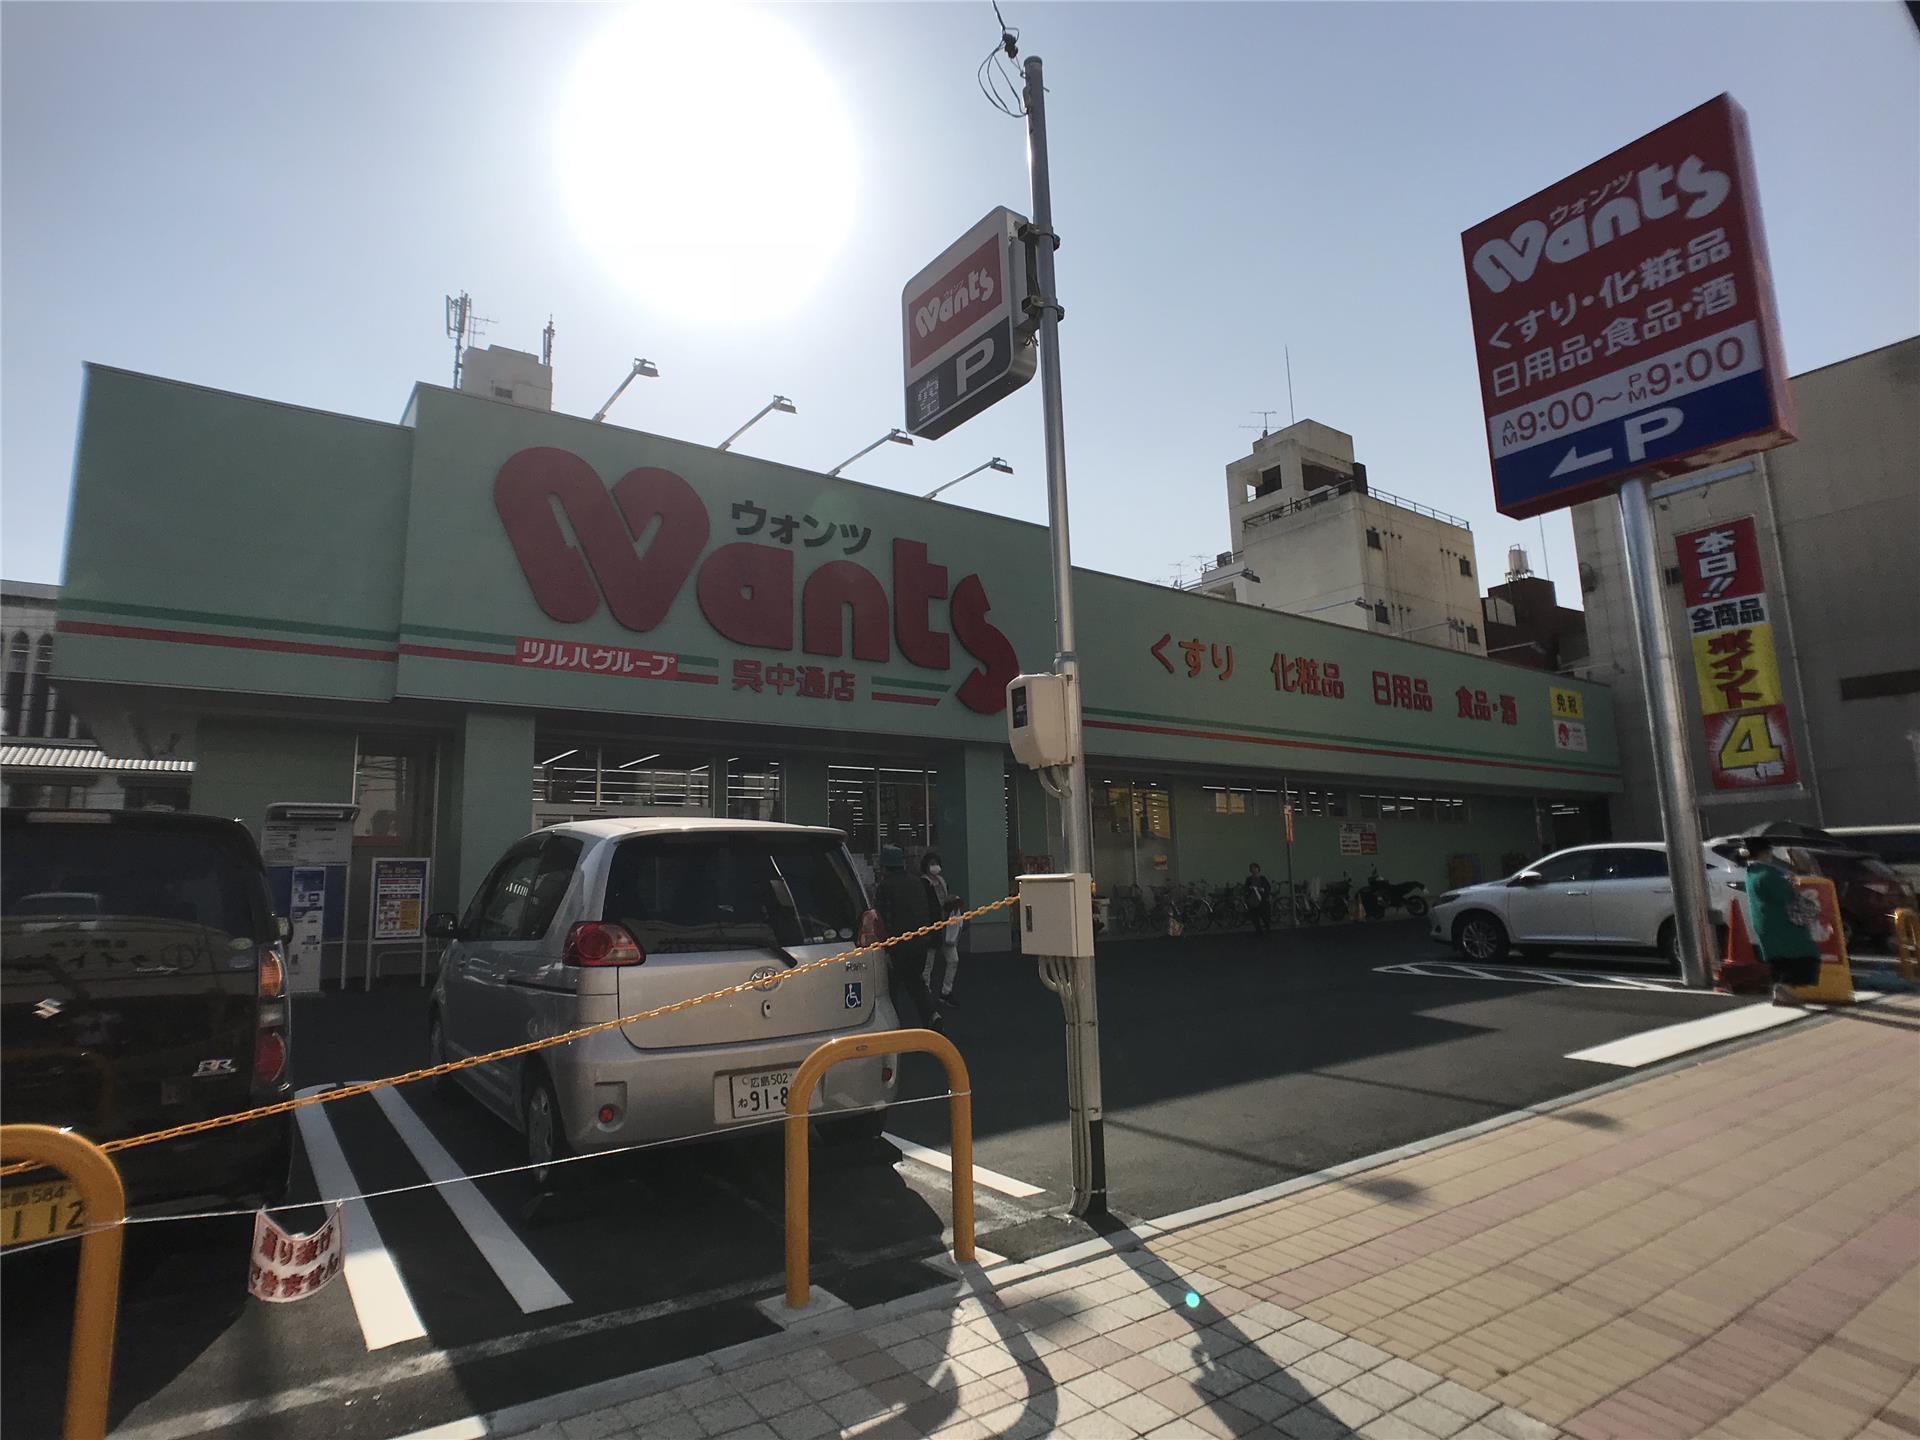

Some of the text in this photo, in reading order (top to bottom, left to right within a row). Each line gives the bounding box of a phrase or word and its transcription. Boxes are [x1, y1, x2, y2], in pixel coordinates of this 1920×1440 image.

[1472, 154, 1731, 293] Wants
[915, 268, 994, 338] Wants
[956, 338, 994, 397] P
[1625, 407, 1684, 463] P
[494, 446, 1020, 715] Wants
[1691, 598, 1765, 633] 全商品
[521, 640, 676, 676] ツルハグループ
[731, 659, 856, 701] 呉中通店
[1150, 633, 1235, 680] くすり
[1271, 651, 1345, 700] 化粧品
[1372, 671, 1433, 712] 日用品
[1707, 629, 1764, 710] ポイント
[750, 1086, 789, 1112] 91-8
